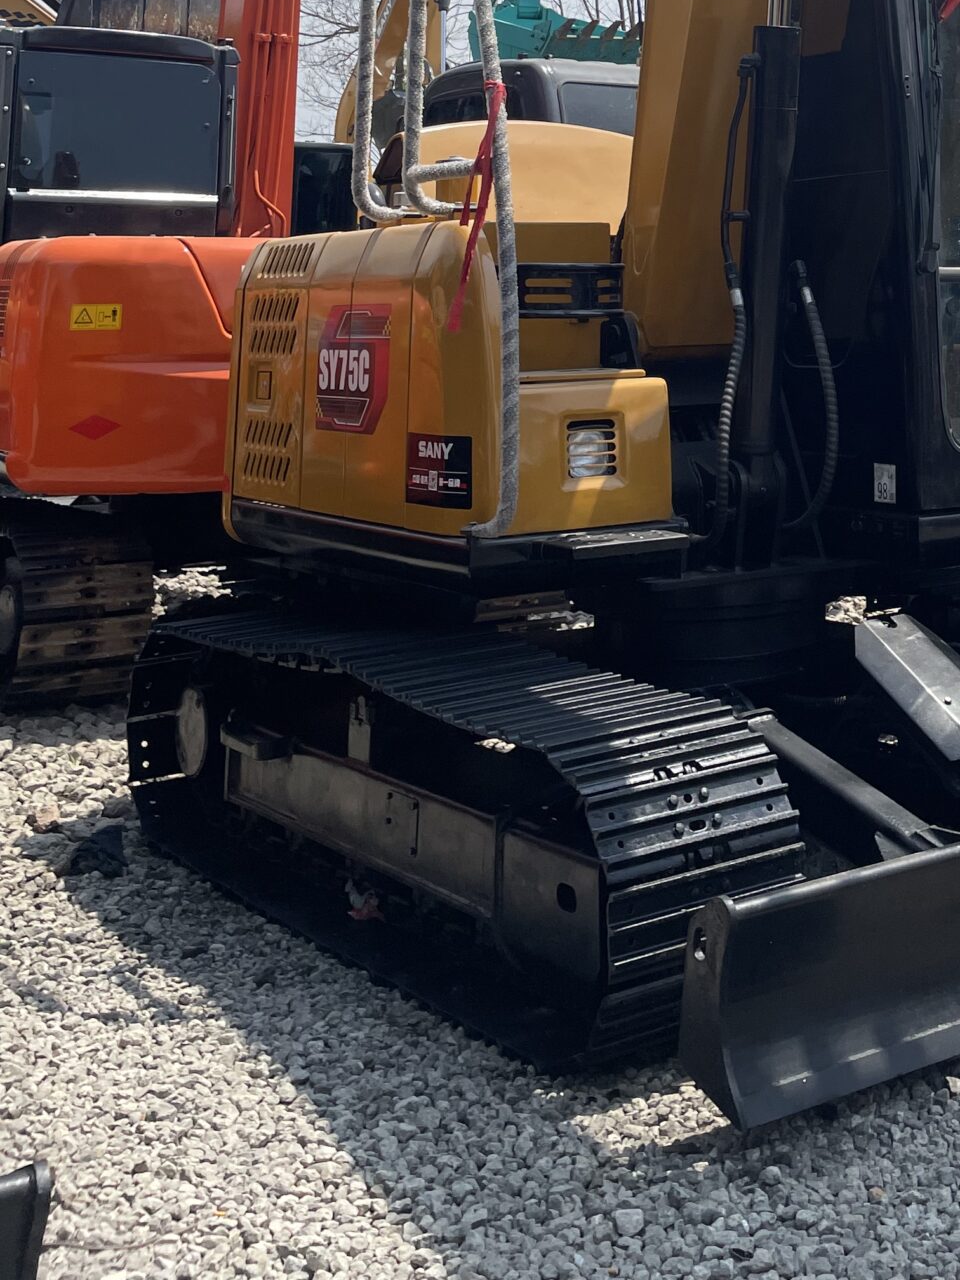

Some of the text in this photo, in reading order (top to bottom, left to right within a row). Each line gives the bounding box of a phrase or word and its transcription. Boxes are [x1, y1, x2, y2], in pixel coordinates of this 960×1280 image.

[319, 348, 370, 393] SY75C
[418, 440, 454, 460] SANY
[877, 481, 888, 499] 98
